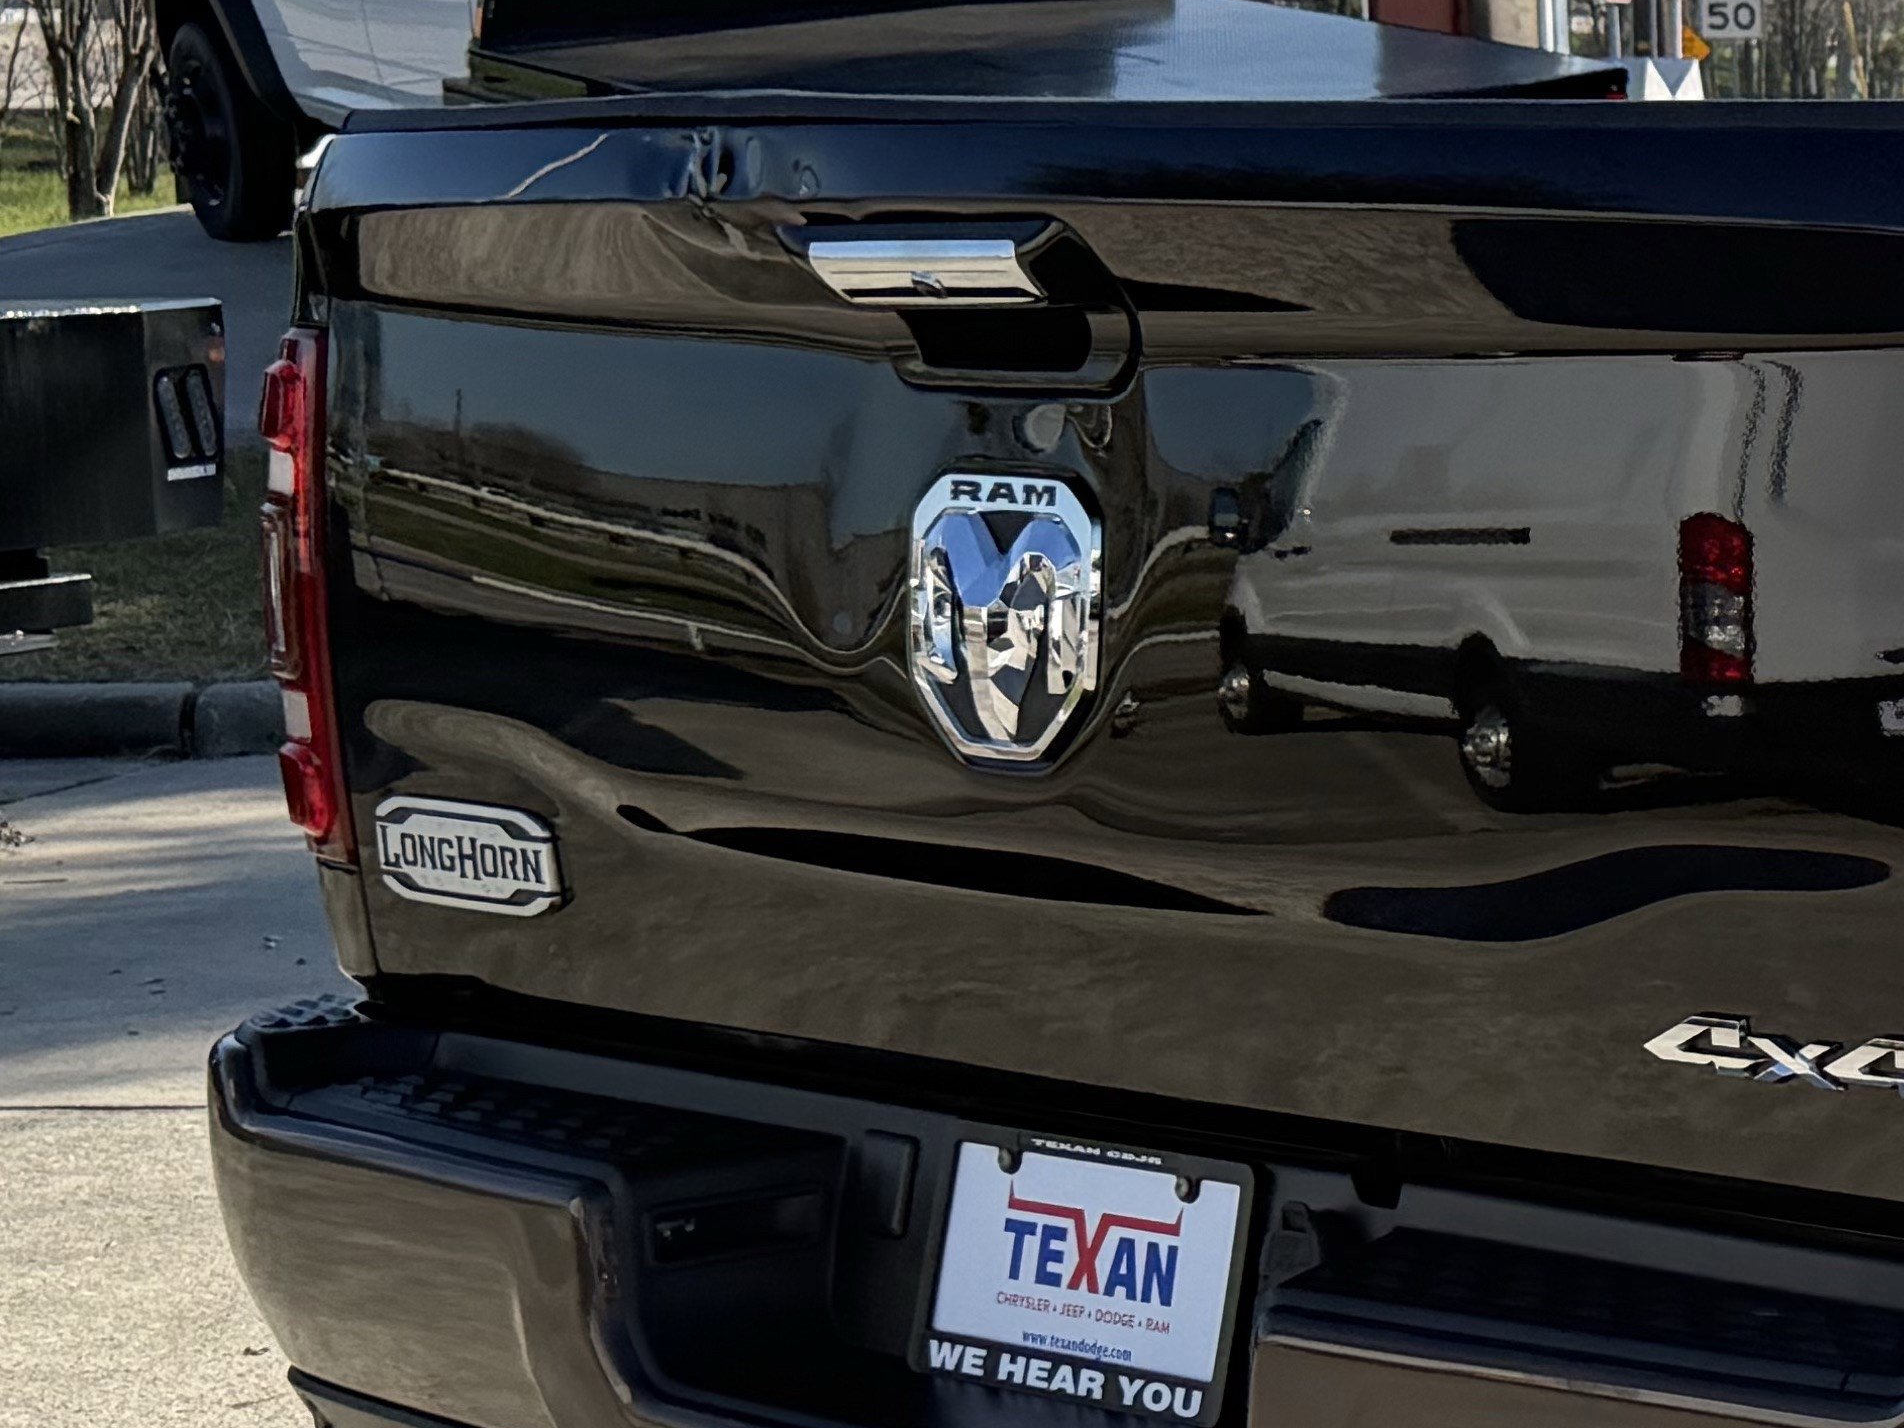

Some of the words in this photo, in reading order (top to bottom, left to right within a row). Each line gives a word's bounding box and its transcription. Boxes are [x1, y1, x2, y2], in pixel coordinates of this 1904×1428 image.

[1707, 2, 1757, 31] 50
[949, 479, 1058, 508] RAM
[1031, 1137, 1101, 1158] TEXAN
[1003, 1182, 1184, 1308] TEXAN
[996, 1290, 1051, 1315] CHRYSLER
[1059, 1302, 1085, 1320] JEEP
[1095, 1307, 1135, 1330] DODGE
[1146, 1317, 1171, 1336] RAM
[1021, 1329, 1133, 1365] www.texandodge.com
[928, 1338, 988, 1378] WE
[997, 1352, 1105, 1401] HEAR
[1118, 1374, 1204, 1420] YOU
